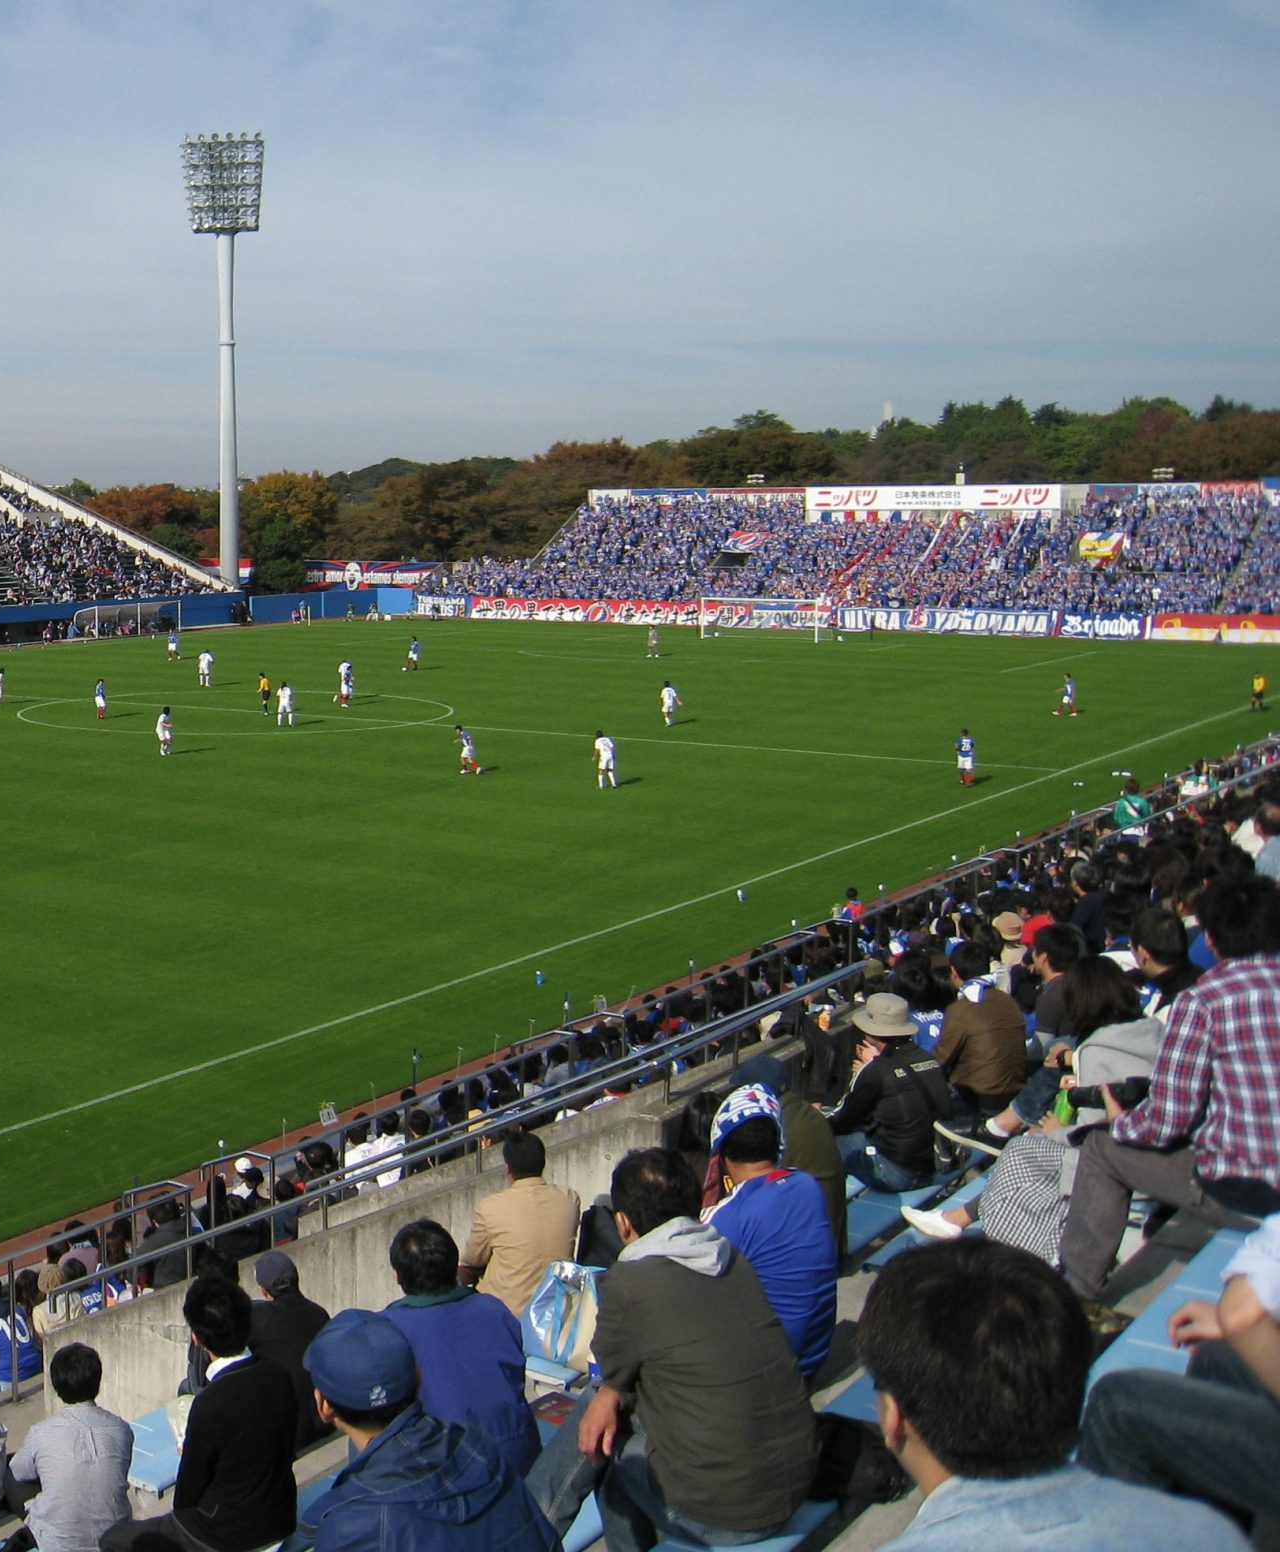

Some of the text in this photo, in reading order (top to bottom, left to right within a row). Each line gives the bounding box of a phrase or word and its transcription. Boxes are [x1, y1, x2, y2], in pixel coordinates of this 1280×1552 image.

[815, 490, 878, 507] ニッパツ
[895, 490, 961, 499] 日本発条株式会社
[980, 488, 1050, 506] ニッパツ
[417, 602, 453, 617] HEDS
[843, 609, 900, 630] ULTRA
